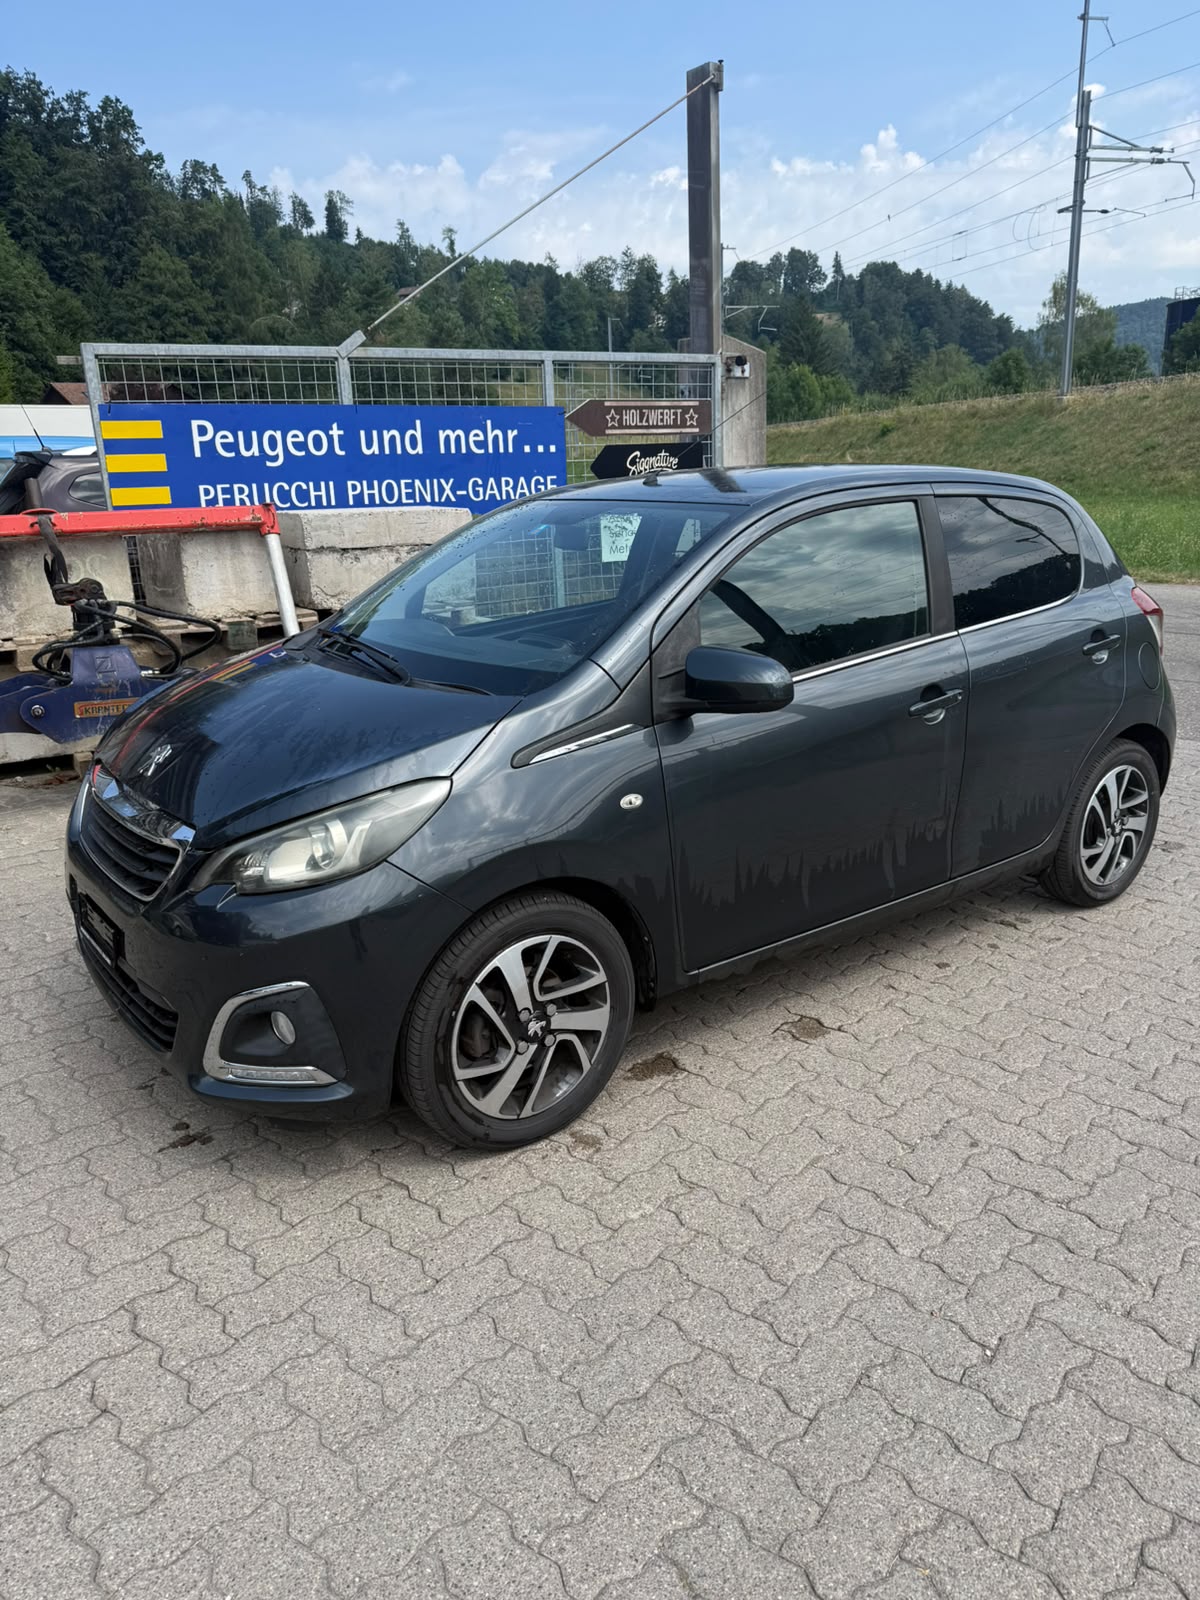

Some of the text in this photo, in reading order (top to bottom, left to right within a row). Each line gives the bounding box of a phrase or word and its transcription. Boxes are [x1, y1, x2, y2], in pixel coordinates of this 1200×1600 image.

[622, 408, 683, 427] HOLZWERFT
[190, 419, 557, 468] Peugeot und mehr...
[626, 449, 679, 476] Siggnature
[198, 475, 558, 508] PERUCCHI PHOENIX-GARAGE
